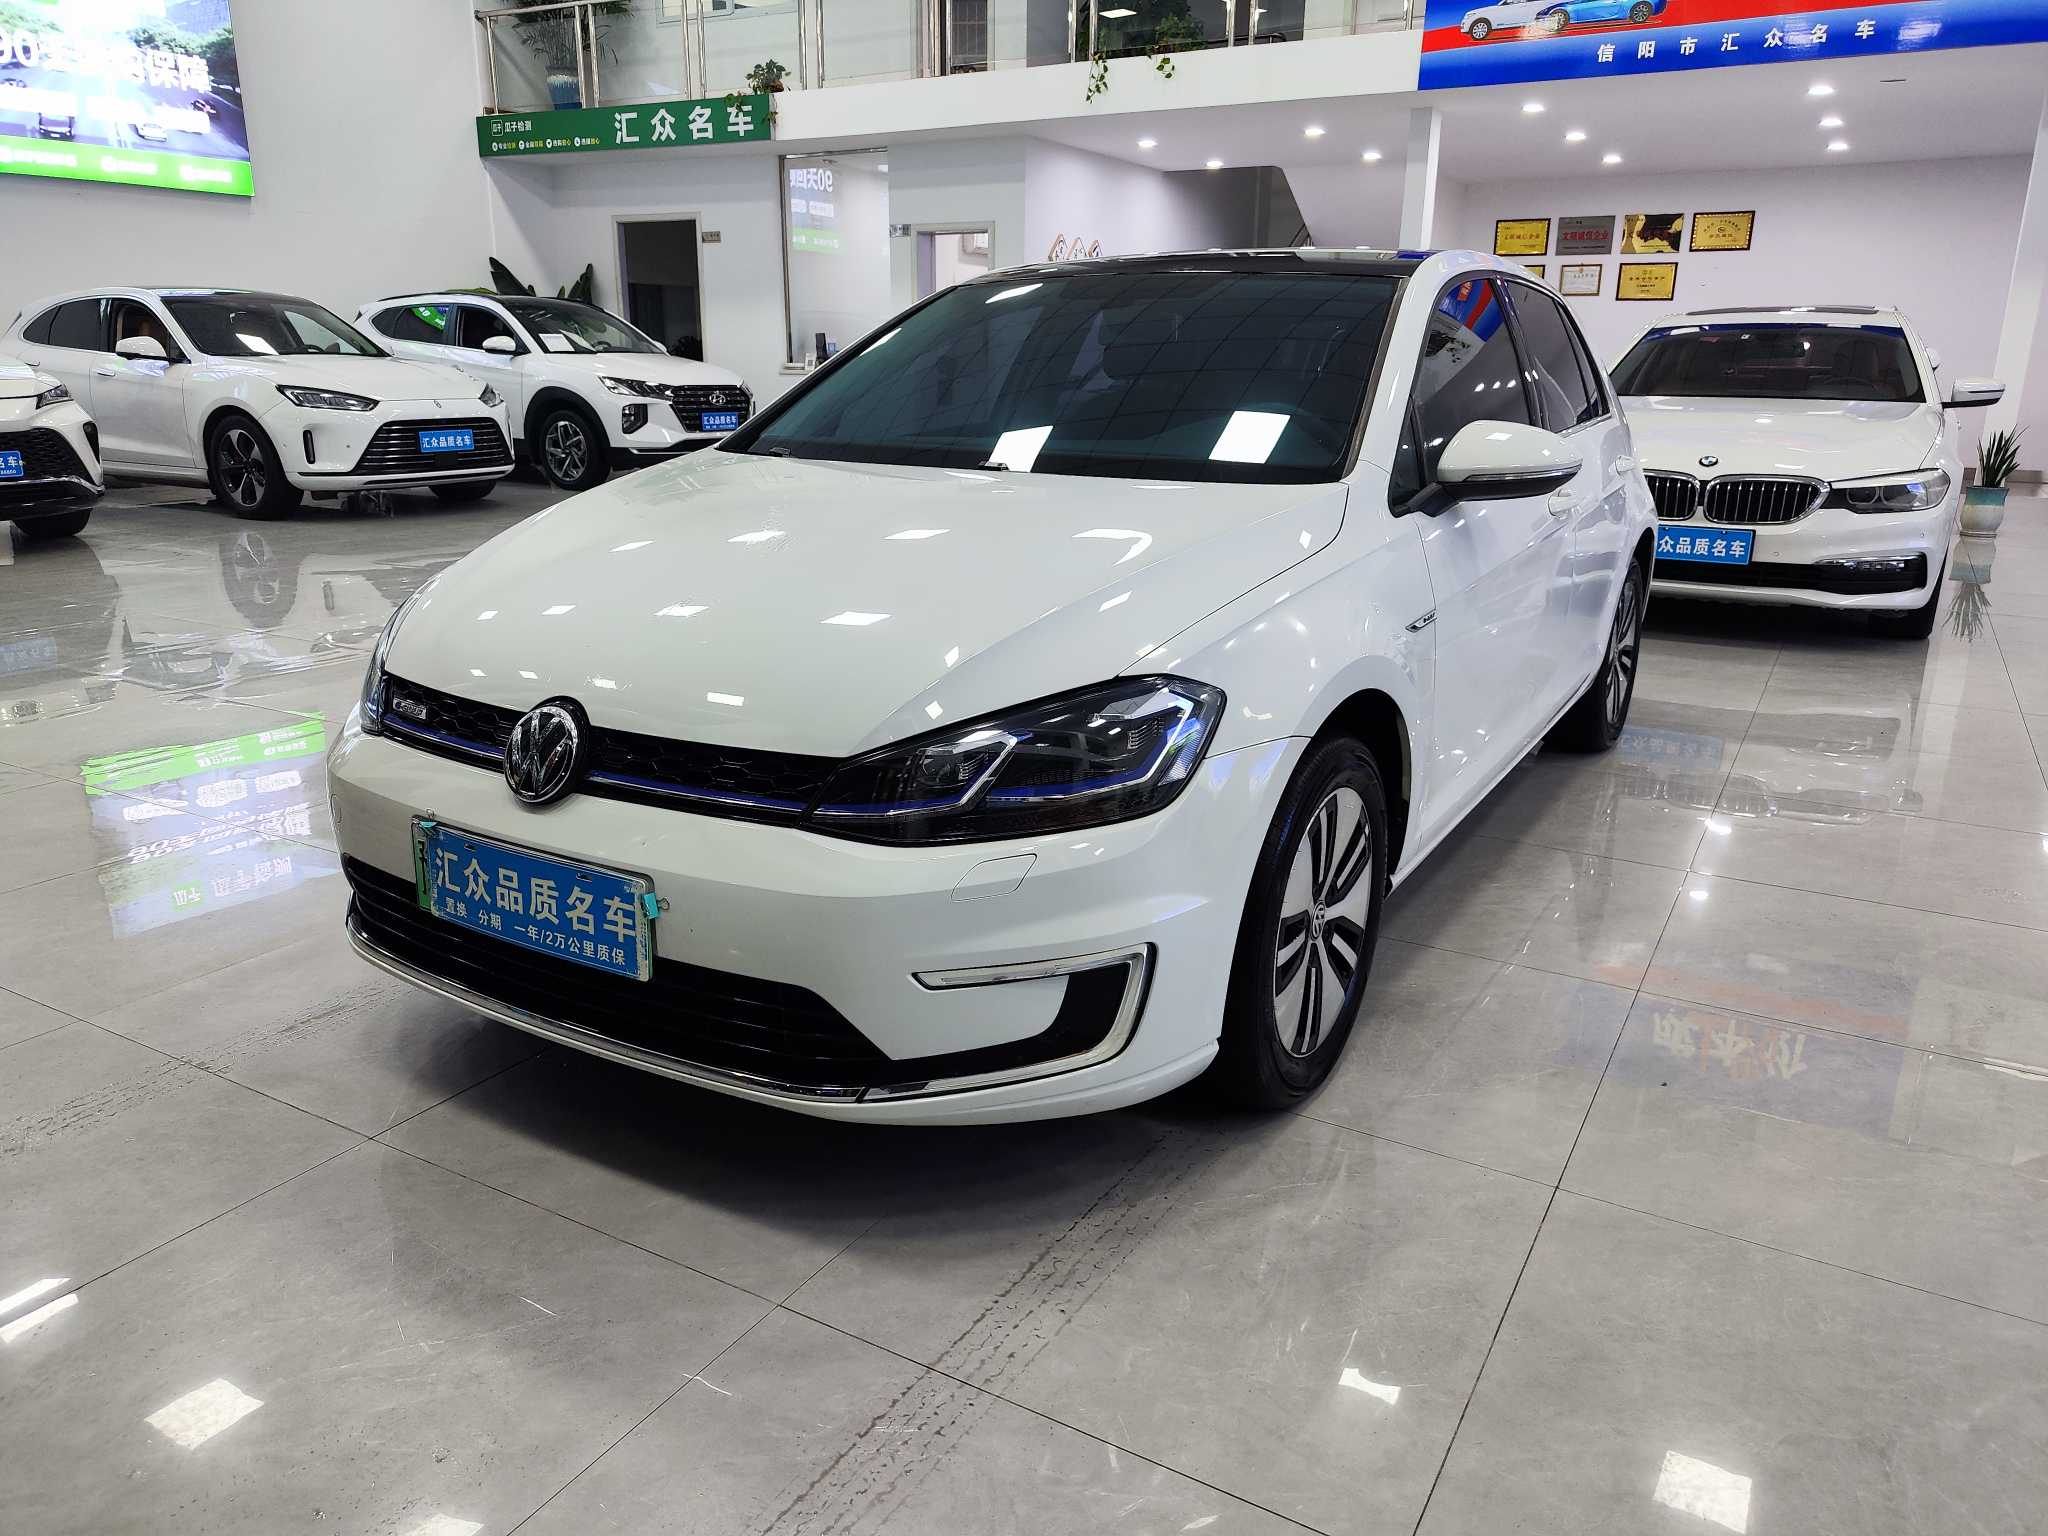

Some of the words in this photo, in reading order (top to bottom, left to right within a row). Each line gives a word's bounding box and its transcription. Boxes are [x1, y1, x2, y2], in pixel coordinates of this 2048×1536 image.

[1597, 19, 1877, 63] 信阳市汇众名车
[505, 120, 532, 133] 瓜子检测
[614, 106, 754, 145] 汇众名车
[423, 435, 472, 448] 汇众品质名车
[1658, 535, 1747, 558] 众品质名车
[434, 847, 637, 944] 汇众品质名车
[478, 909, 503, 931] 分期
[514, 925, 626, 966] 一年/2万公里质保
